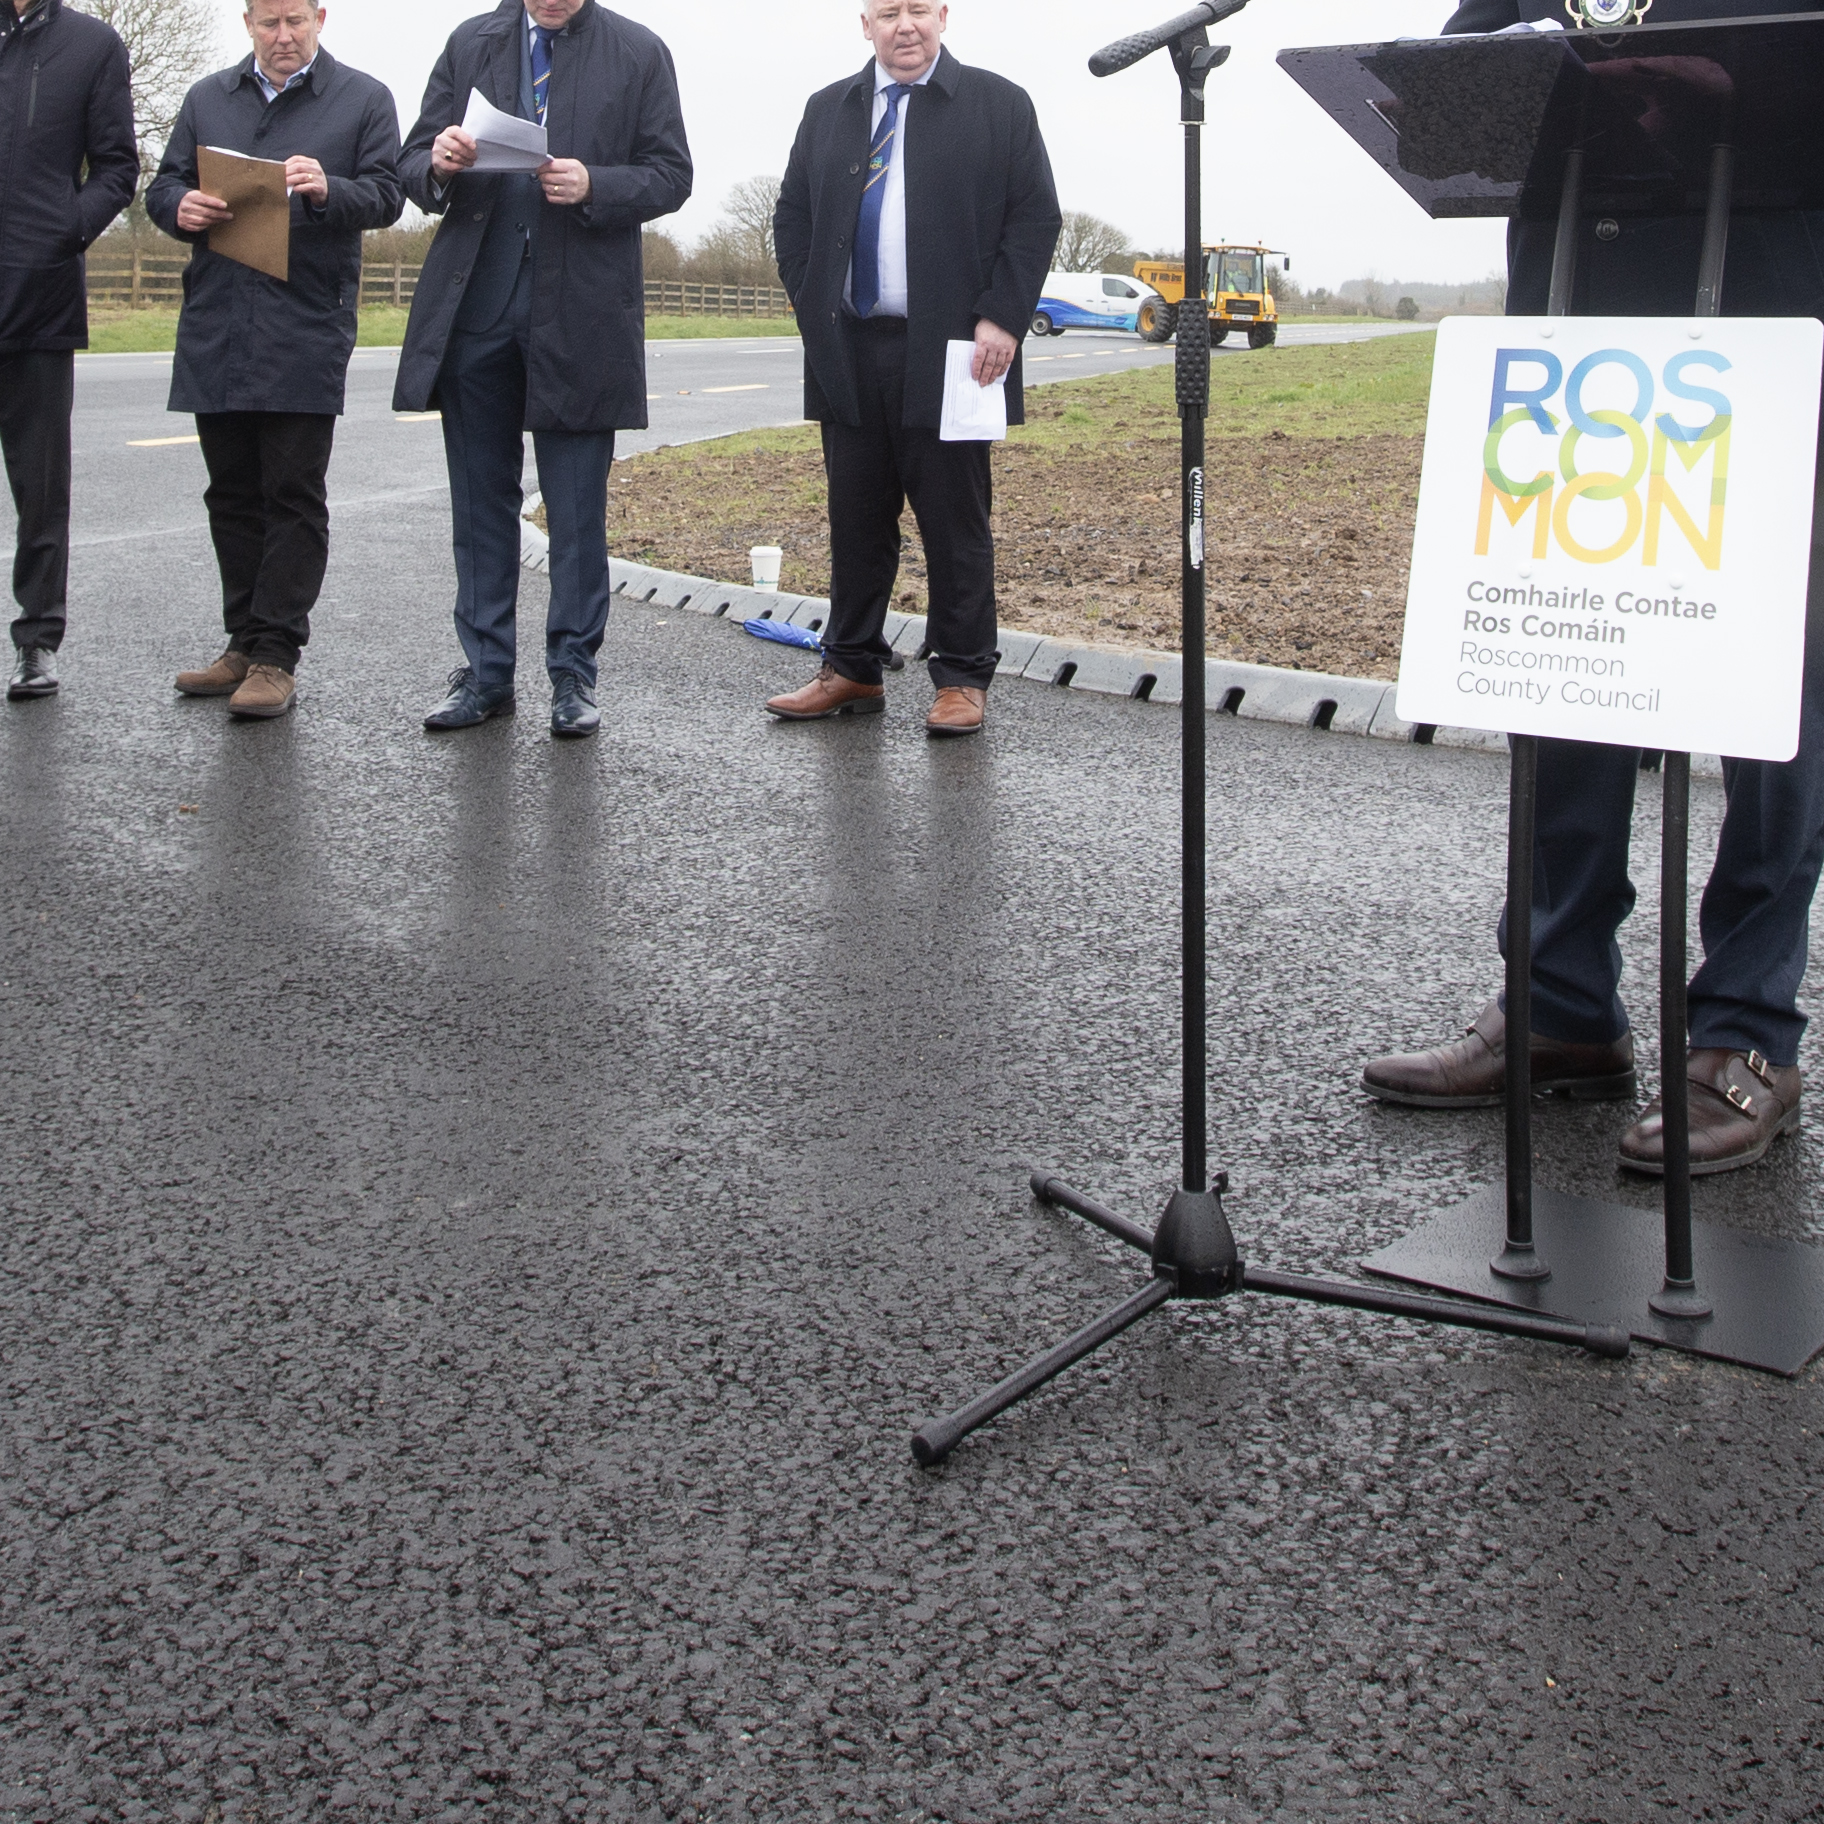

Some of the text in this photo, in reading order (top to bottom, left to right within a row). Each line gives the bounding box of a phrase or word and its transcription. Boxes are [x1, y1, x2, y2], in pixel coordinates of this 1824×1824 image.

[1487, 348, 1733, 442] ROS
[1482, 406, 1733, 506] COM
[1474, 468, 1727, 571] MON
[1466, 579, 1718, 620] Comhairle Contae
[1462, 609, 1626, 644] Ros Comáin
[1459, 640, 1626, 678] Roscommon
[1456, 671, 1661, 713] County Council
